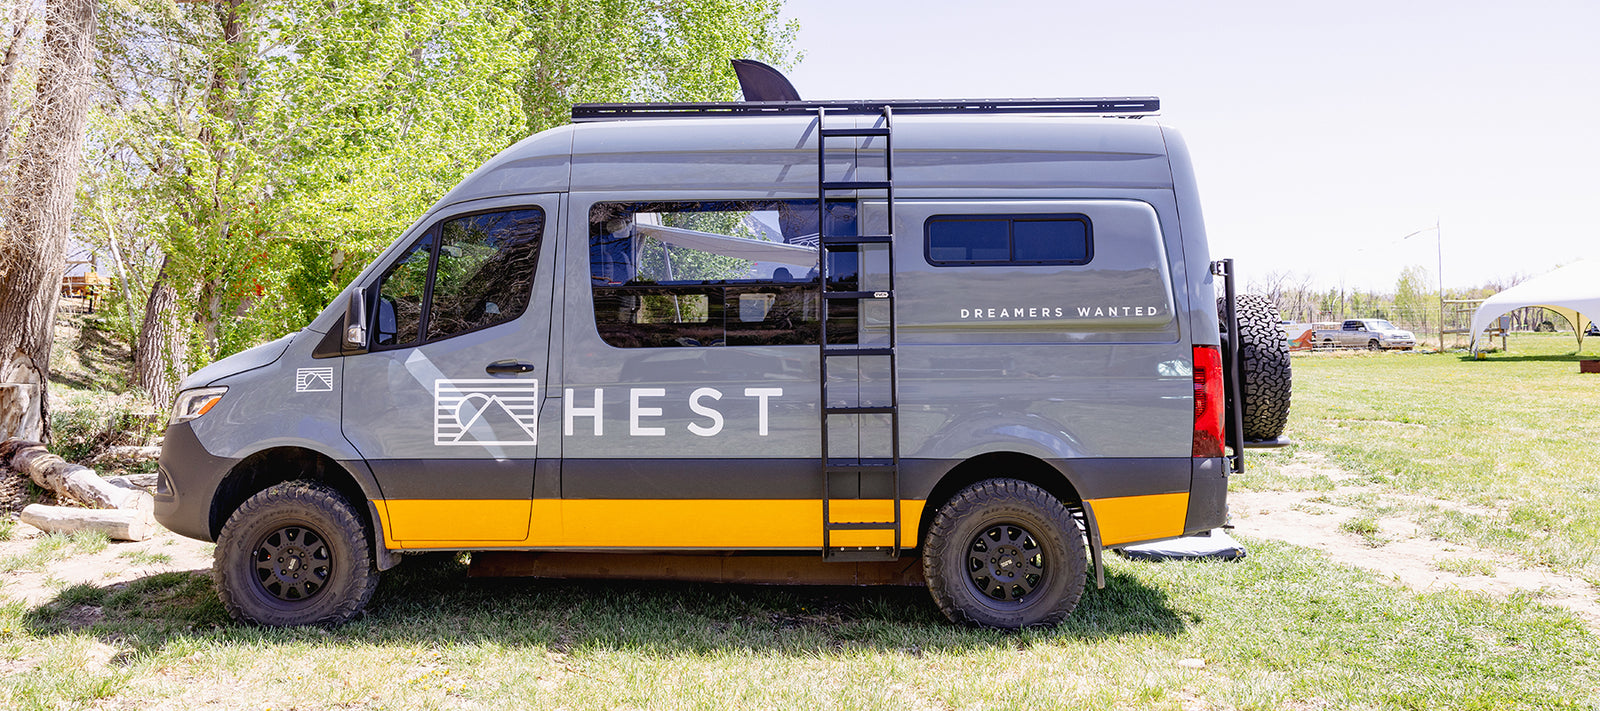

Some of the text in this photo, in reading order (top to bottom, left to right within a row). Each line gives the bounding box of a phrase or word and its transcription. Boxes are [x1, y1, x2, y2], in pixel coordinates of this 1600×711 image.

[960, 306, 1158, 319] DREAMERS WANTED
[565, 387, 783, 437] HEST
